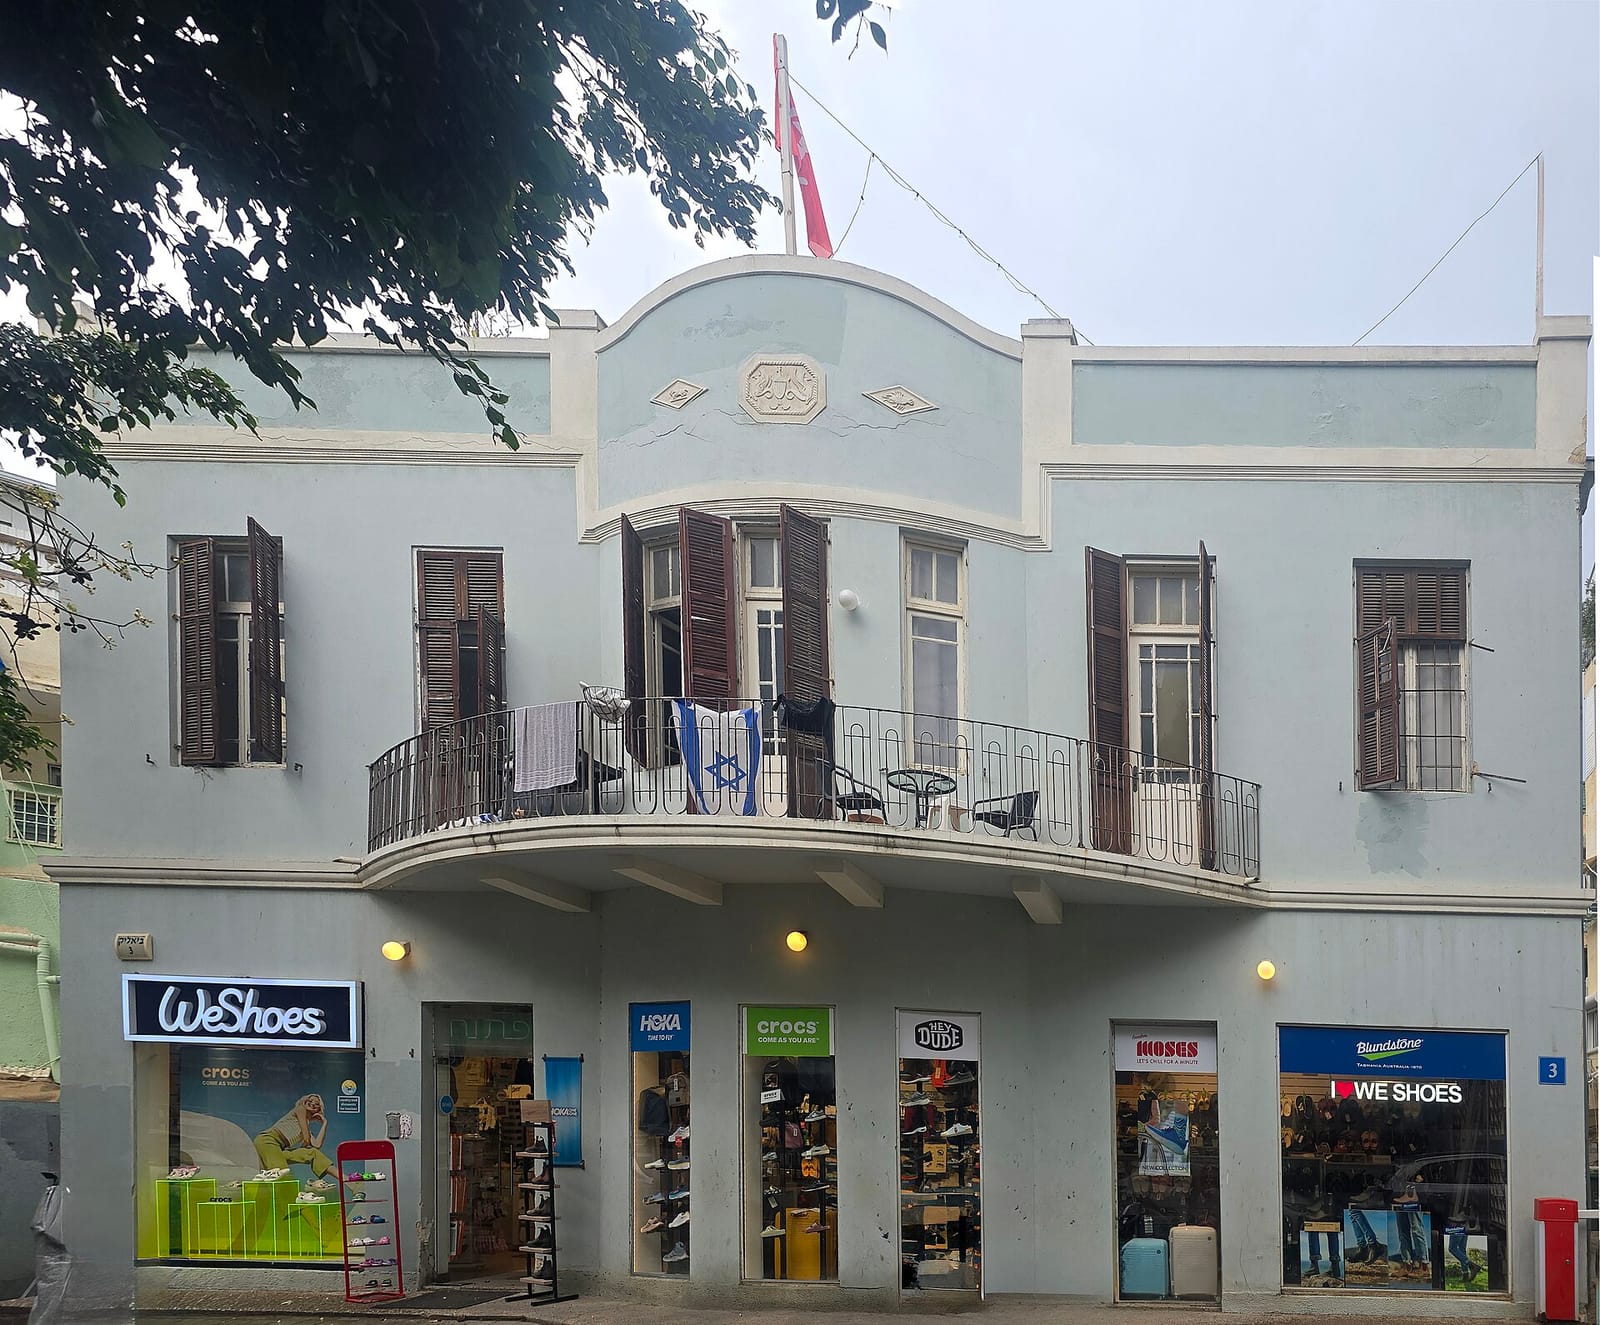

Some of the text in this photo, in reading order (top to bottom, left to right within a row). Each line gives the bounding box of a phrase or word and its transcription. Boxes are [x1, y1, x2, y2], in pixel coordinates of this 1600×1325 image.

[118, 936, 144, 946] ביאליק
[158, 985, 327, 1035] WeShoes
[640, 1013, 681, 1032] HOKA
[757, 1020, 817, 1034] crocs
[928, 1021, 952, 1034] HEY
[803, 1036, 817, 1044] ARE
[917, 1026, 960, 1049] DUDE
[1136, 1040, 1199, 1058] MOSES
[1356, 1038, 1422, 1054] Blundstone
[201, 1067, 250, 1079] crocs
[1548, 1062, 1558, 1078] 3
[1330, 1080, 1463, 1104] I WE SHOES
